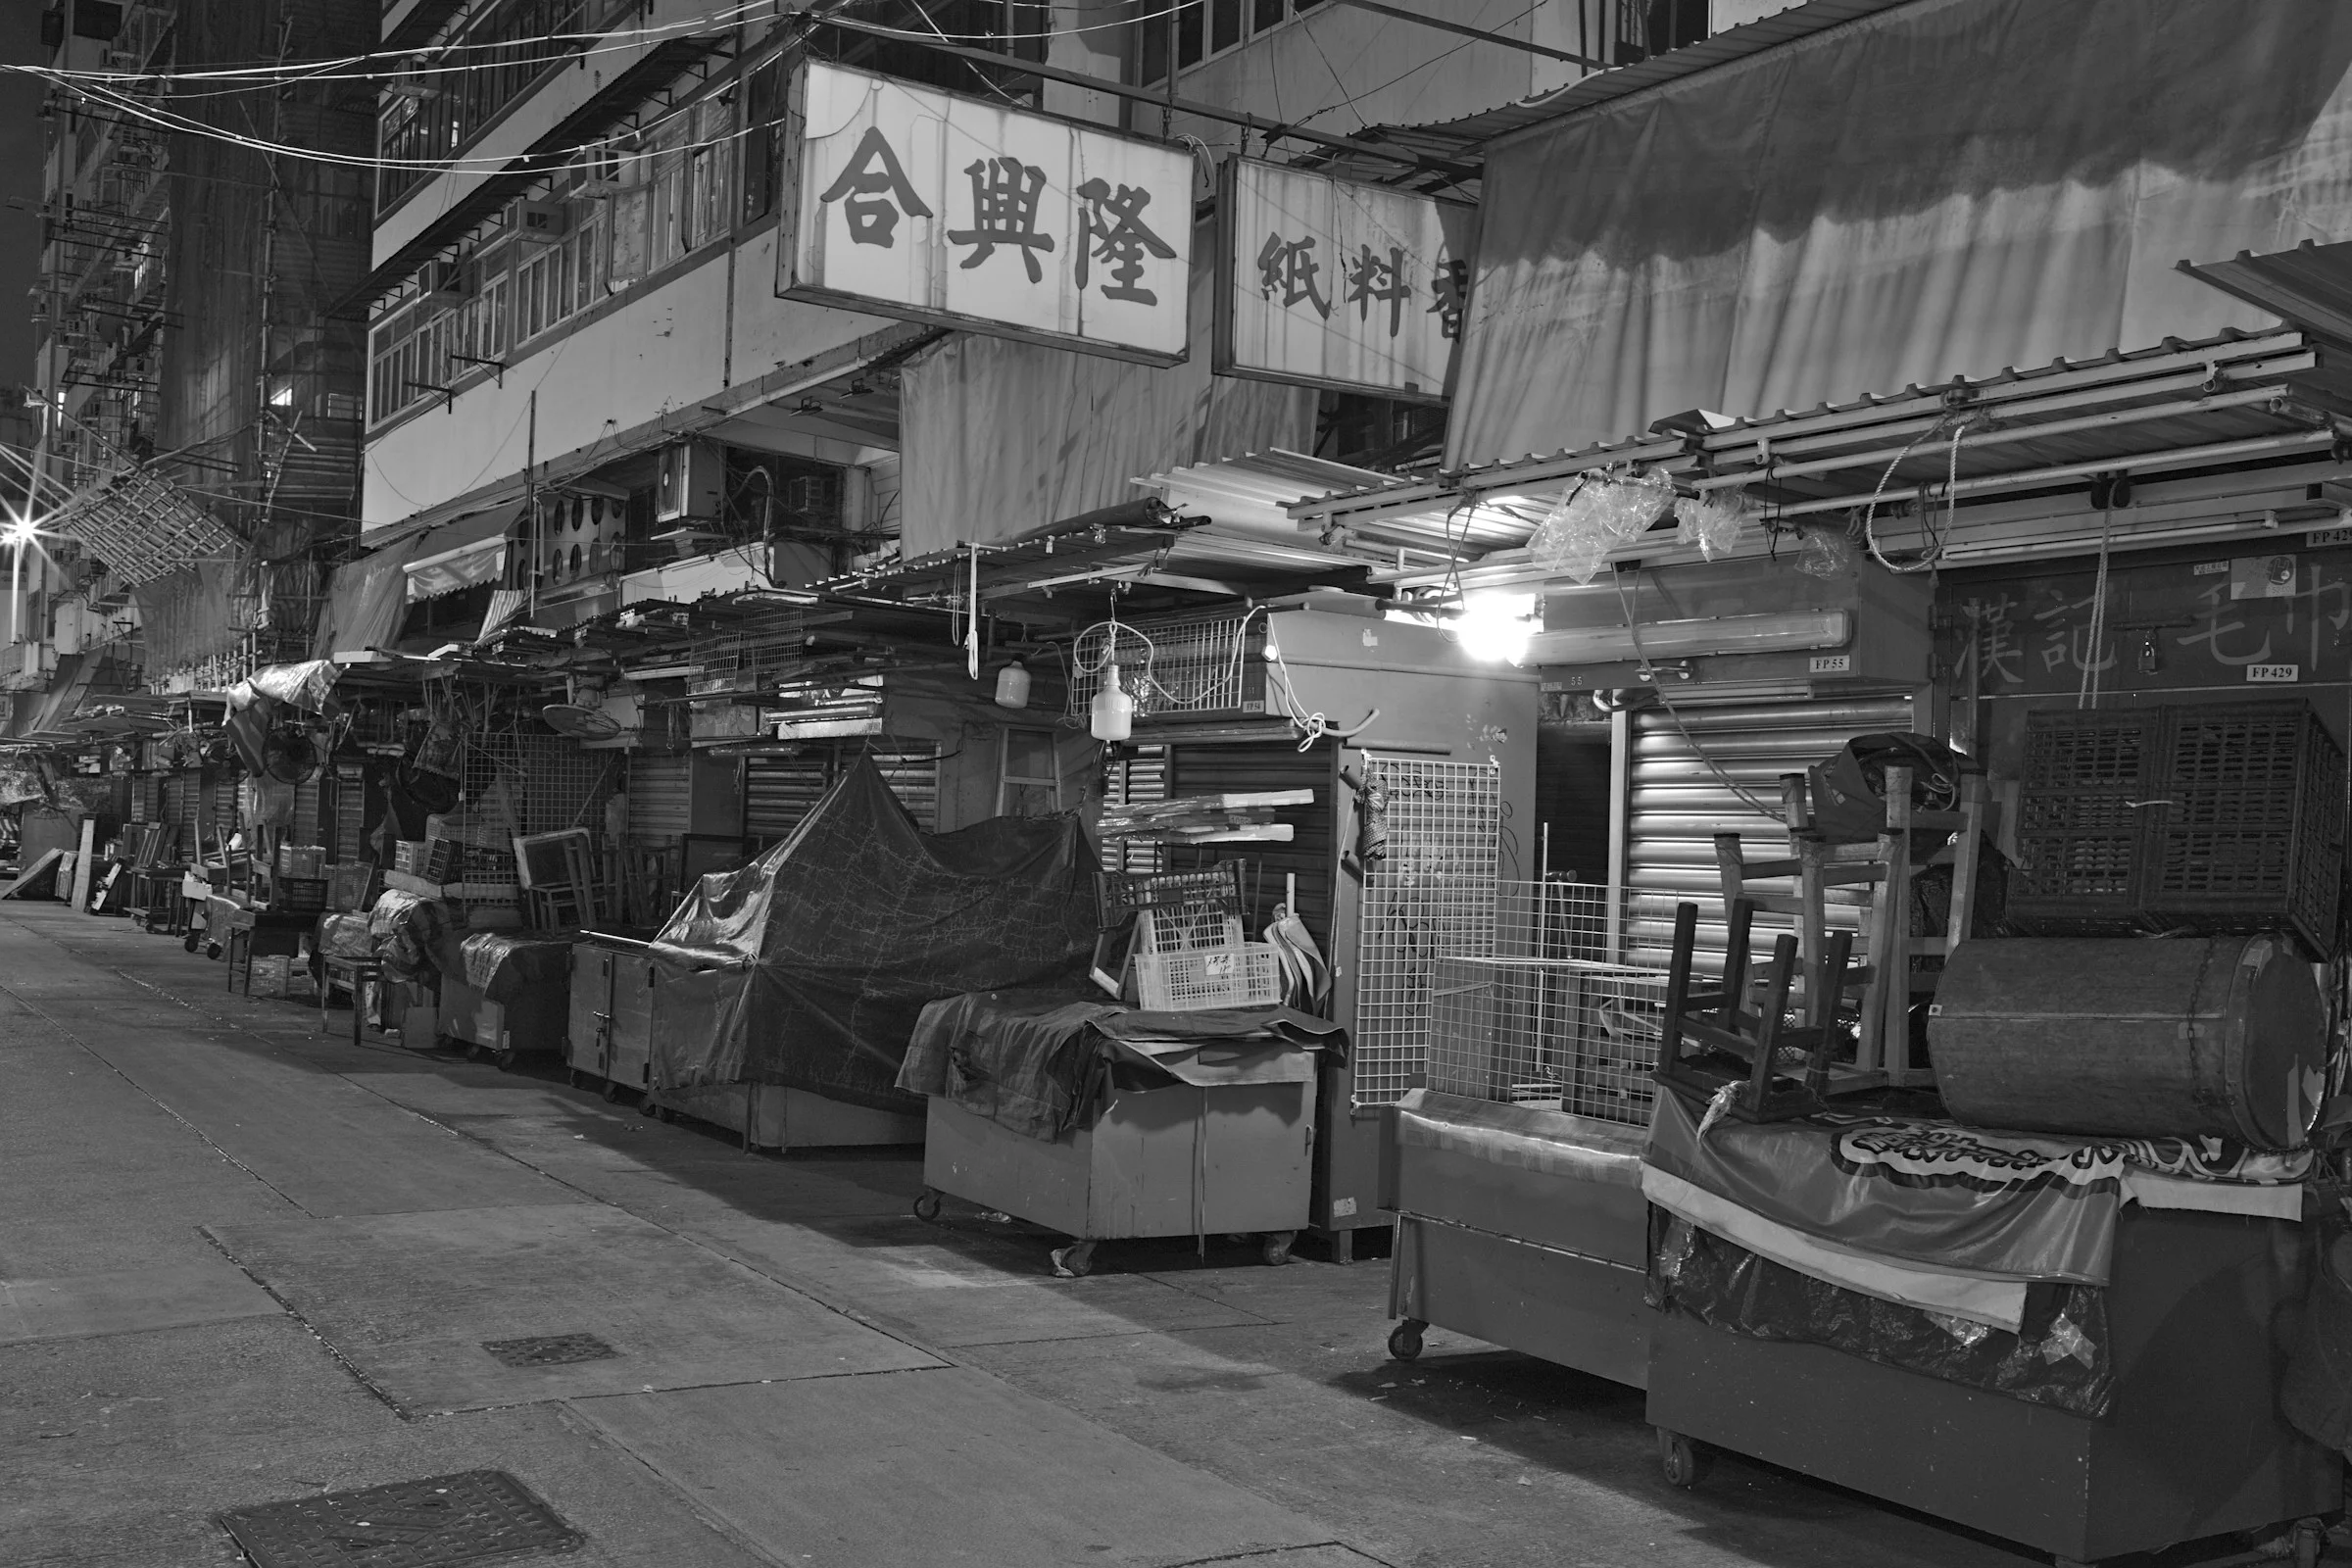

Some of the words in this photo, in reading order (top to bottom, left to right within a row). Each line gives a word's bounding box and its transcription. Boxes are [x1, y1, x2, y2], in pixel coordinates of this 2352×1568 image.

[820, 125, 1176, 306] 合興隆
[2313, 531, 2330, 544] FP
[1816, 659, 1830, 669] FP
[1832, 659, 1843, 668] 55
[2252, 666, 2270, 678] FP
[2271, 666, 2293, 678] 429
[1570, 675, 1584, 687] 55
